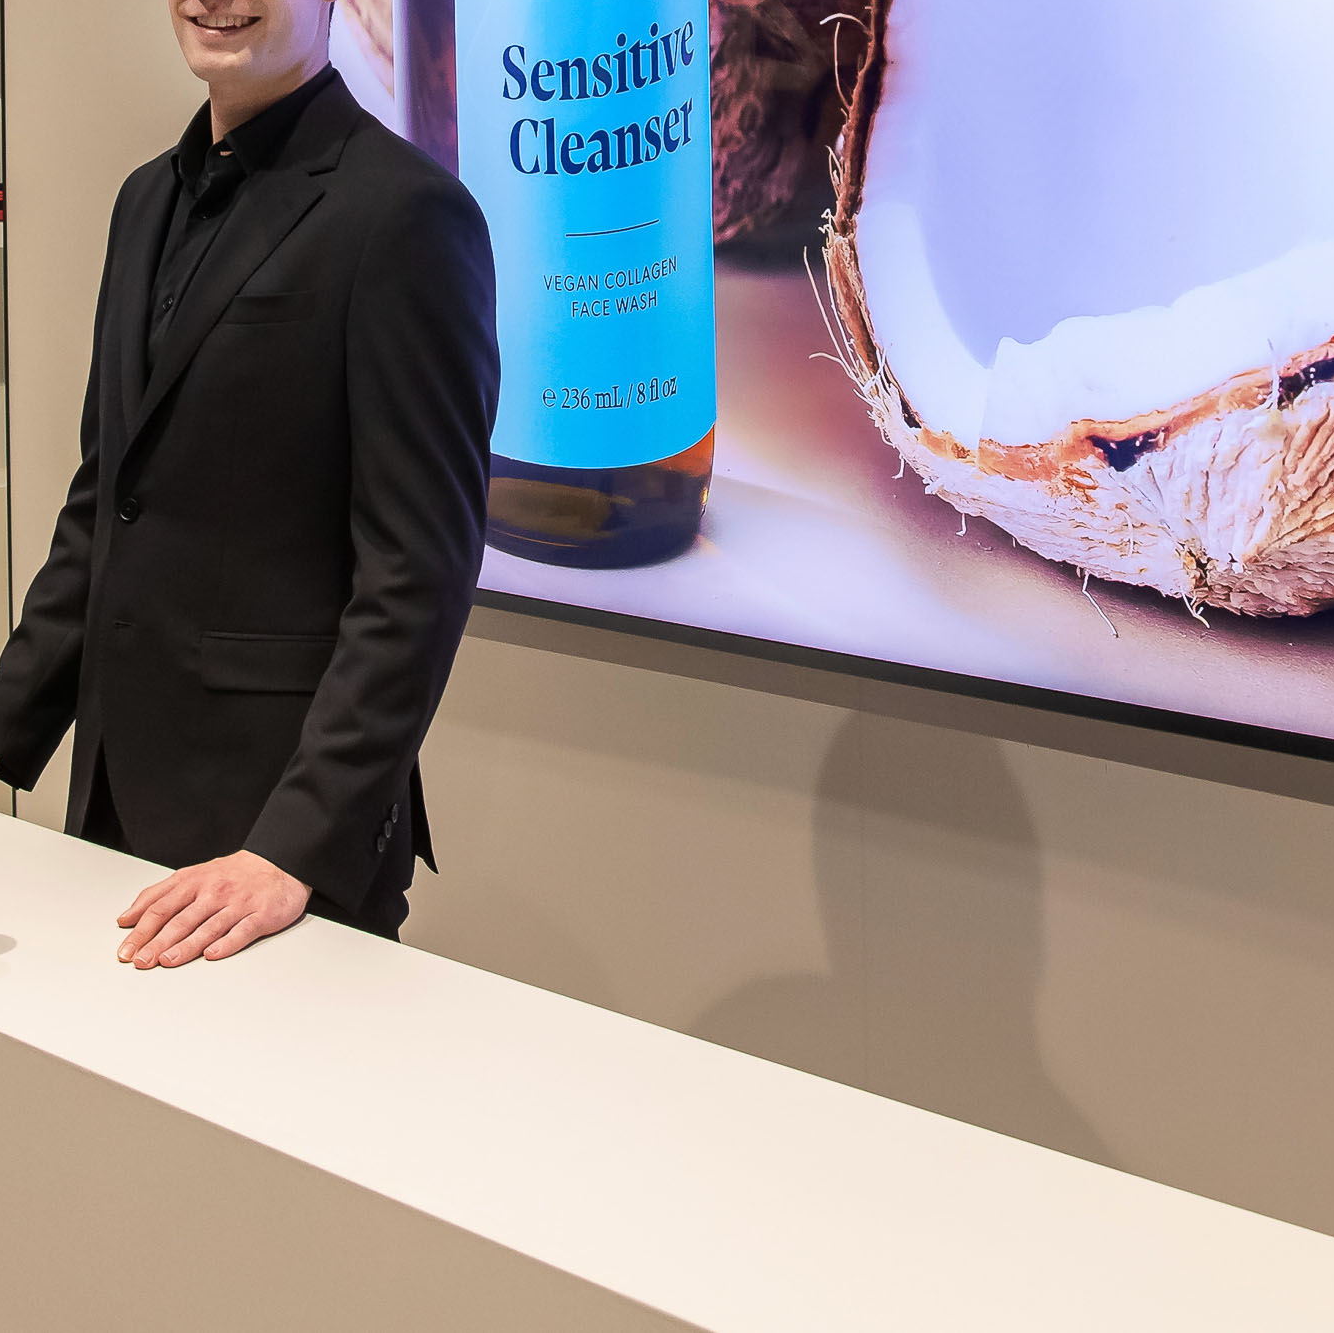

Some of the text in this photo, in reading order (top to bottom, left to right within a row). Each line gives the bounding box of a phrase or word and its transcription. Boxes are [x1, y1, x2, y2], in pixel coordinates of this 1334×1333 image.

[502, 20, 695, 102] Sensitive
[509, 97, 693, 175] Cleanser
[543, 255, 677, 292] VEGAN COLLAGEN
[571, 289, 657, 317] FACE WASH
[561, 387, 590, 410] 236
[594, 385, 624, 409] mL
[636, 382, 646, 404] 8
[649, 377, 660, 402] fl
[662, 376, 677, 398] oz
